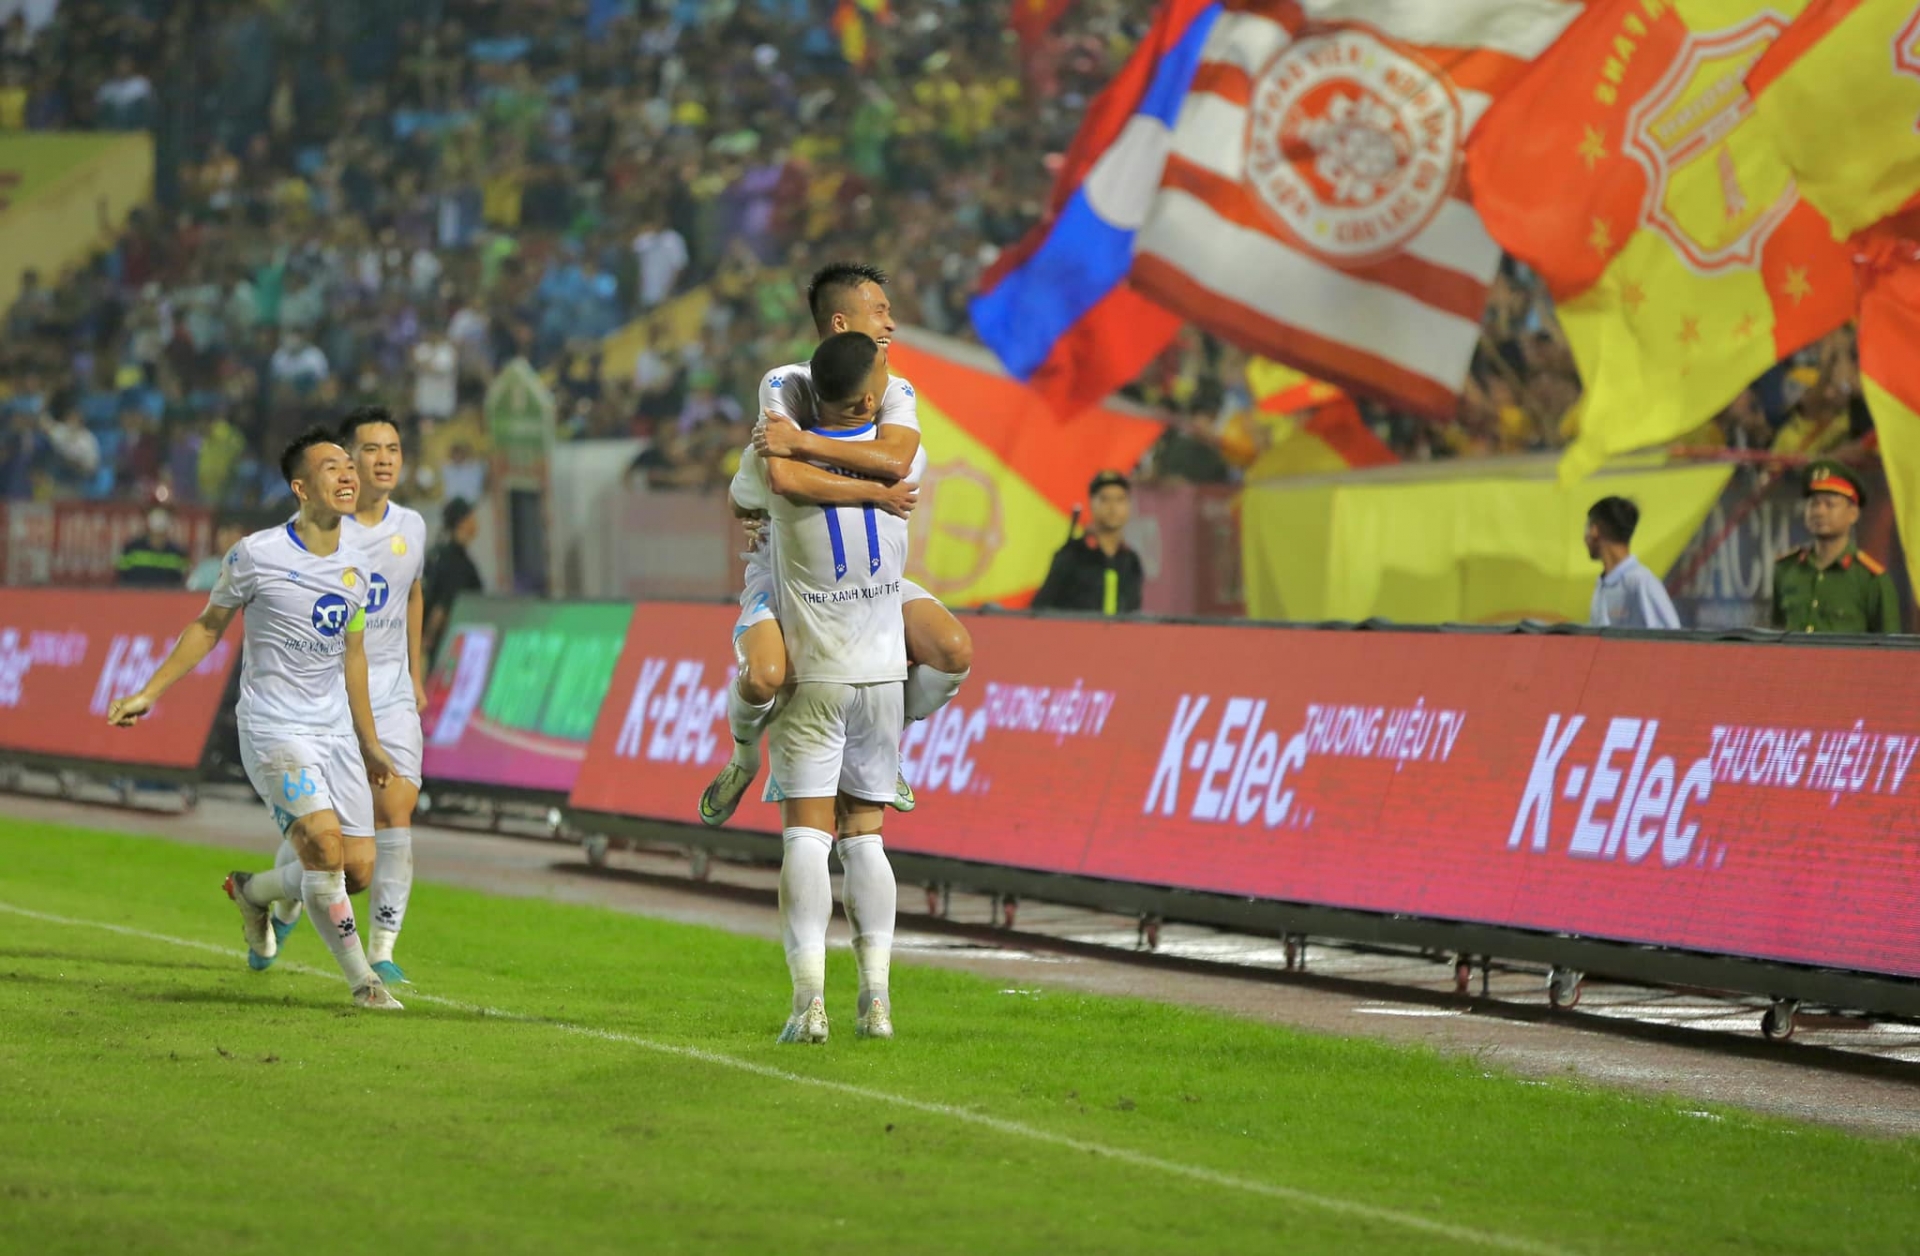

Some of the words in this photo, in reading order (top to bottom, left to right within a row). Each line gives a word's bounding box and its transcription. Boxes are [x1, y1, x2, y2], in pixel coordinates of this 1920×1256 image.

[831, 588, 859, 603] XANH
[1083, 690, 1117, 737] TV
[283, 767, 316, 803] 66
[1143, 694, 1307, 830] K-Elec
[1428, 708, 1467, 763] TV
[1506, 712, 1714, 870] K-Elec
[1873, 734, 1920, 795] TV
